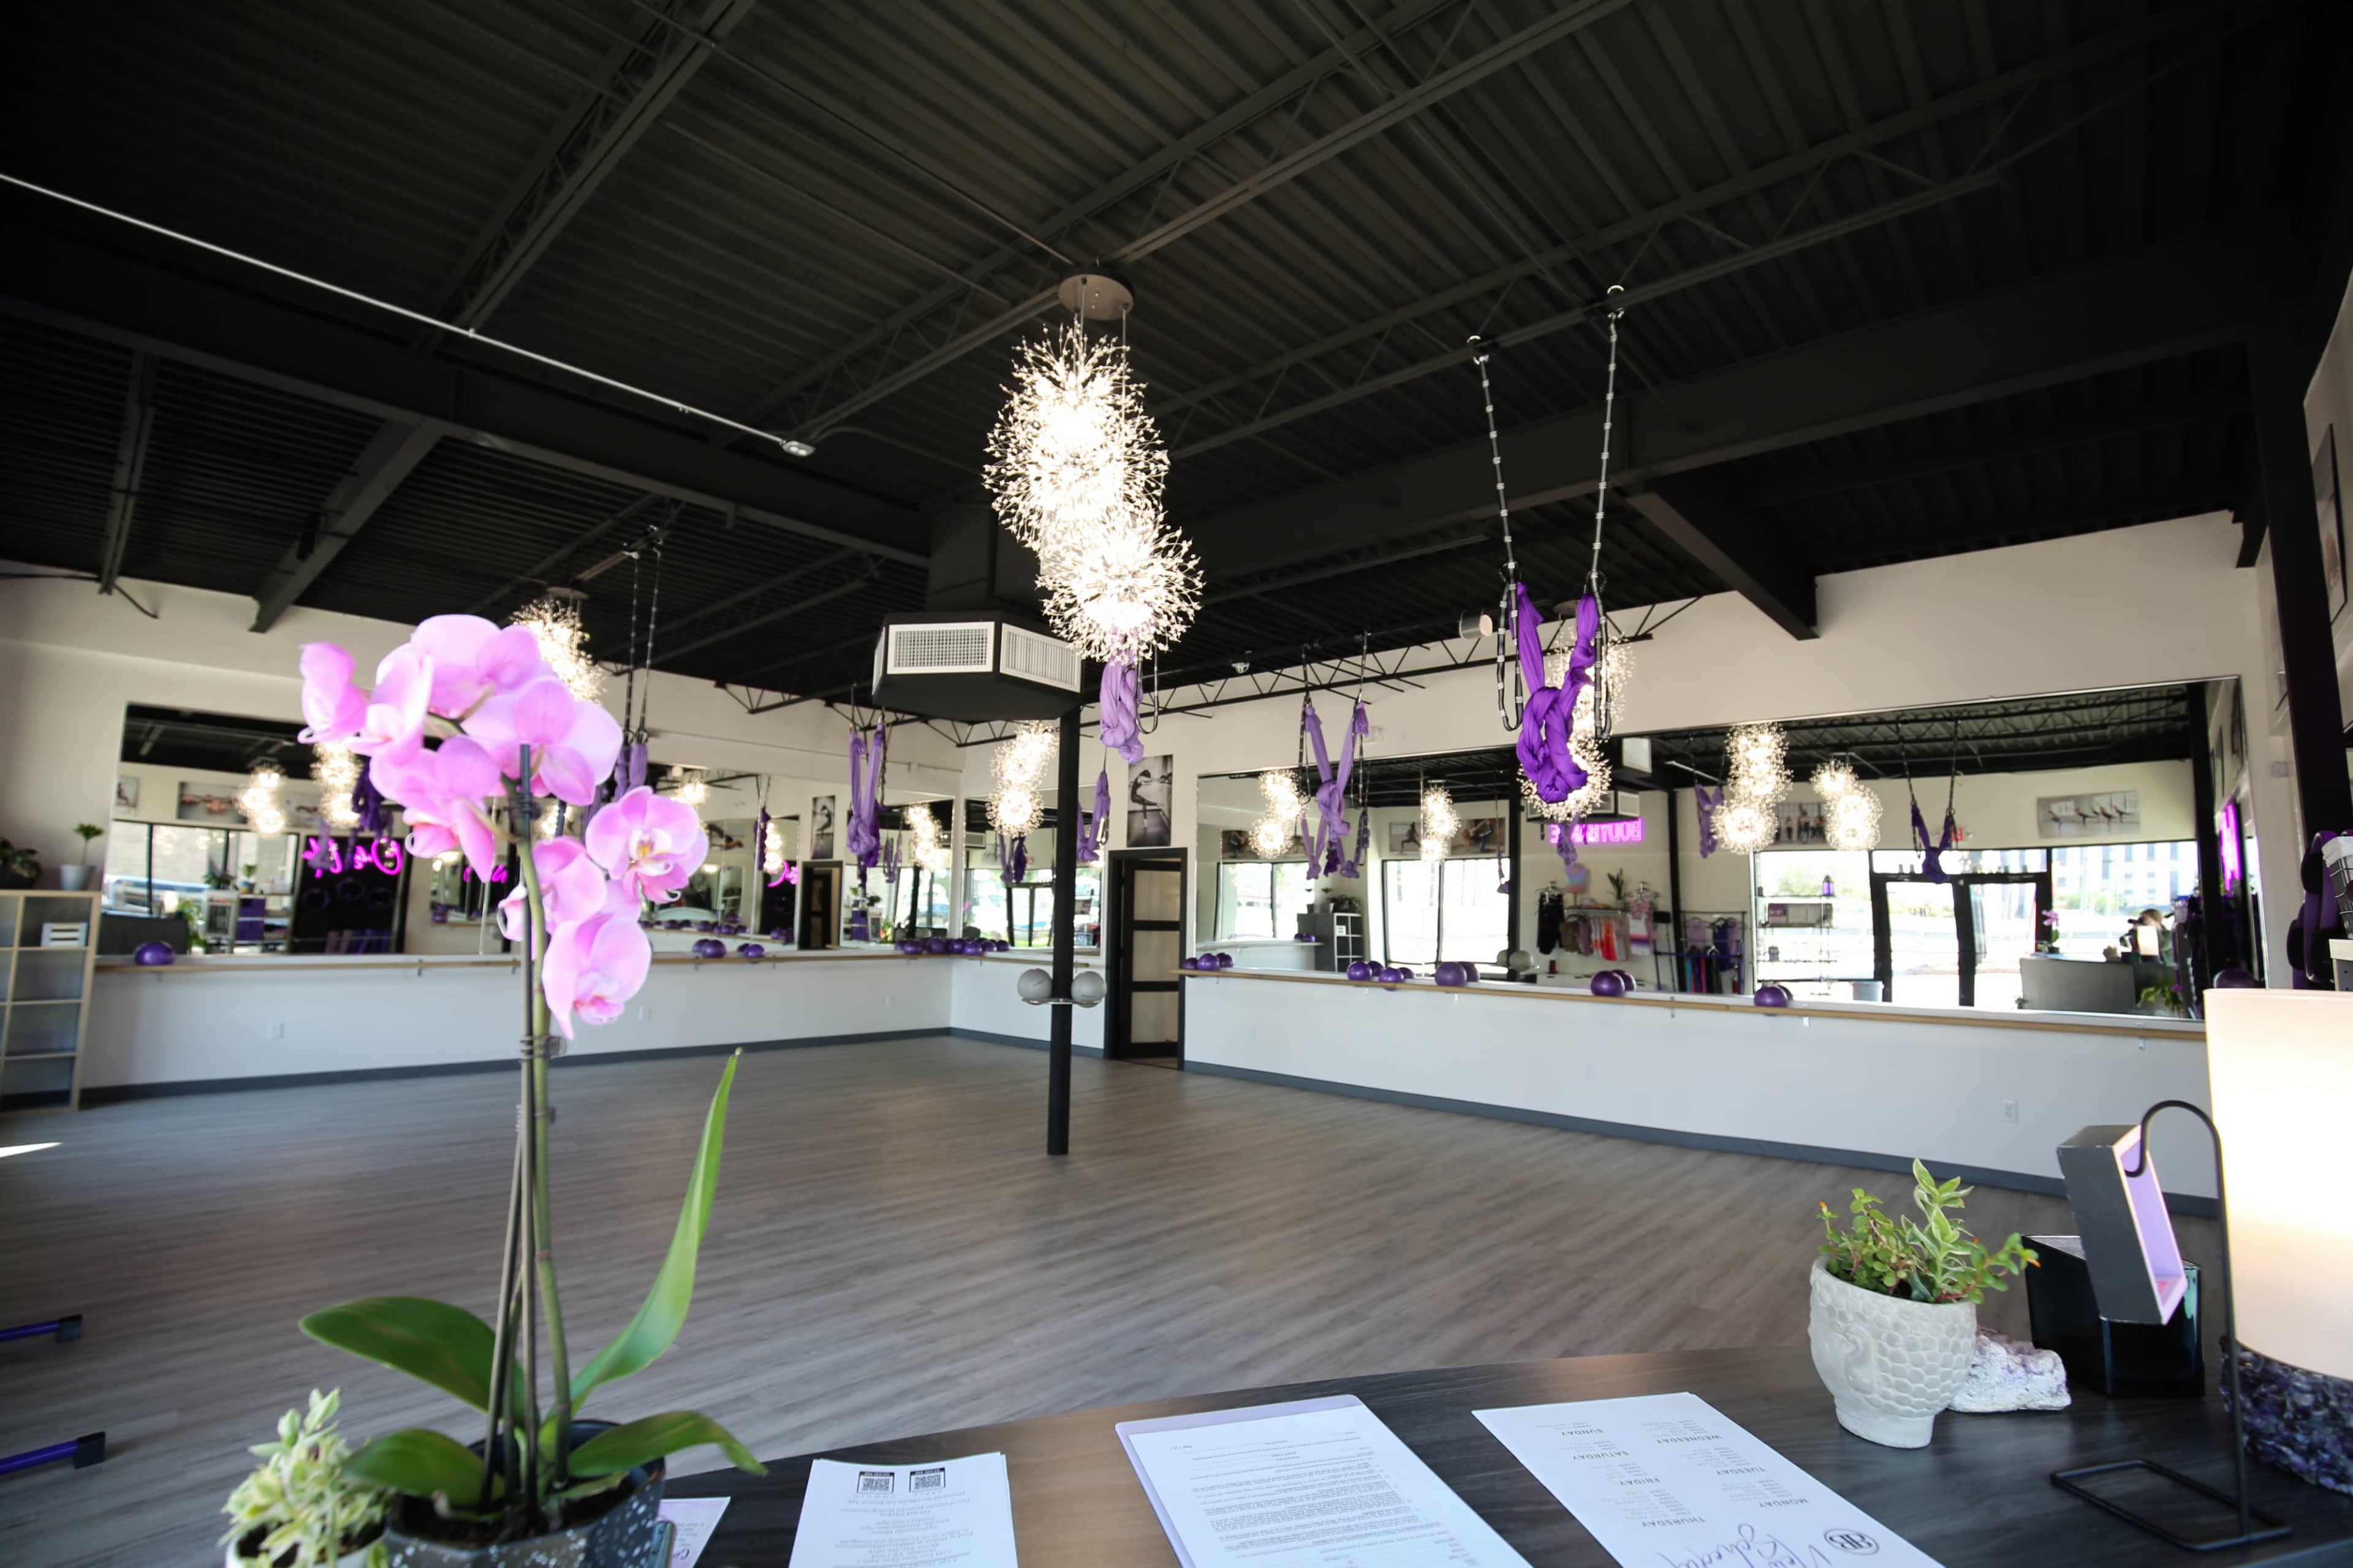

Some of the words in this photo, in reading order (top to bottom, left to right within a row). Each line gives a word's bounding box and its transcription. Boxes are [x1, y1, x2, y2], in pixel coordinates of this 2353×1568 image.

[1657, 1434, 1722, 1444] WEDNESDAY
[1572, 1450, 1629, 1461] SATURDAY
[1716, 1466, 1766, 1476] TUESDAY
[1620, 1477, 1660, 1486] FRIDAY
[1759, 1498, 1809, 1508] MONDAY
[1642, 1516, 1706, 1528] THURSDAY
